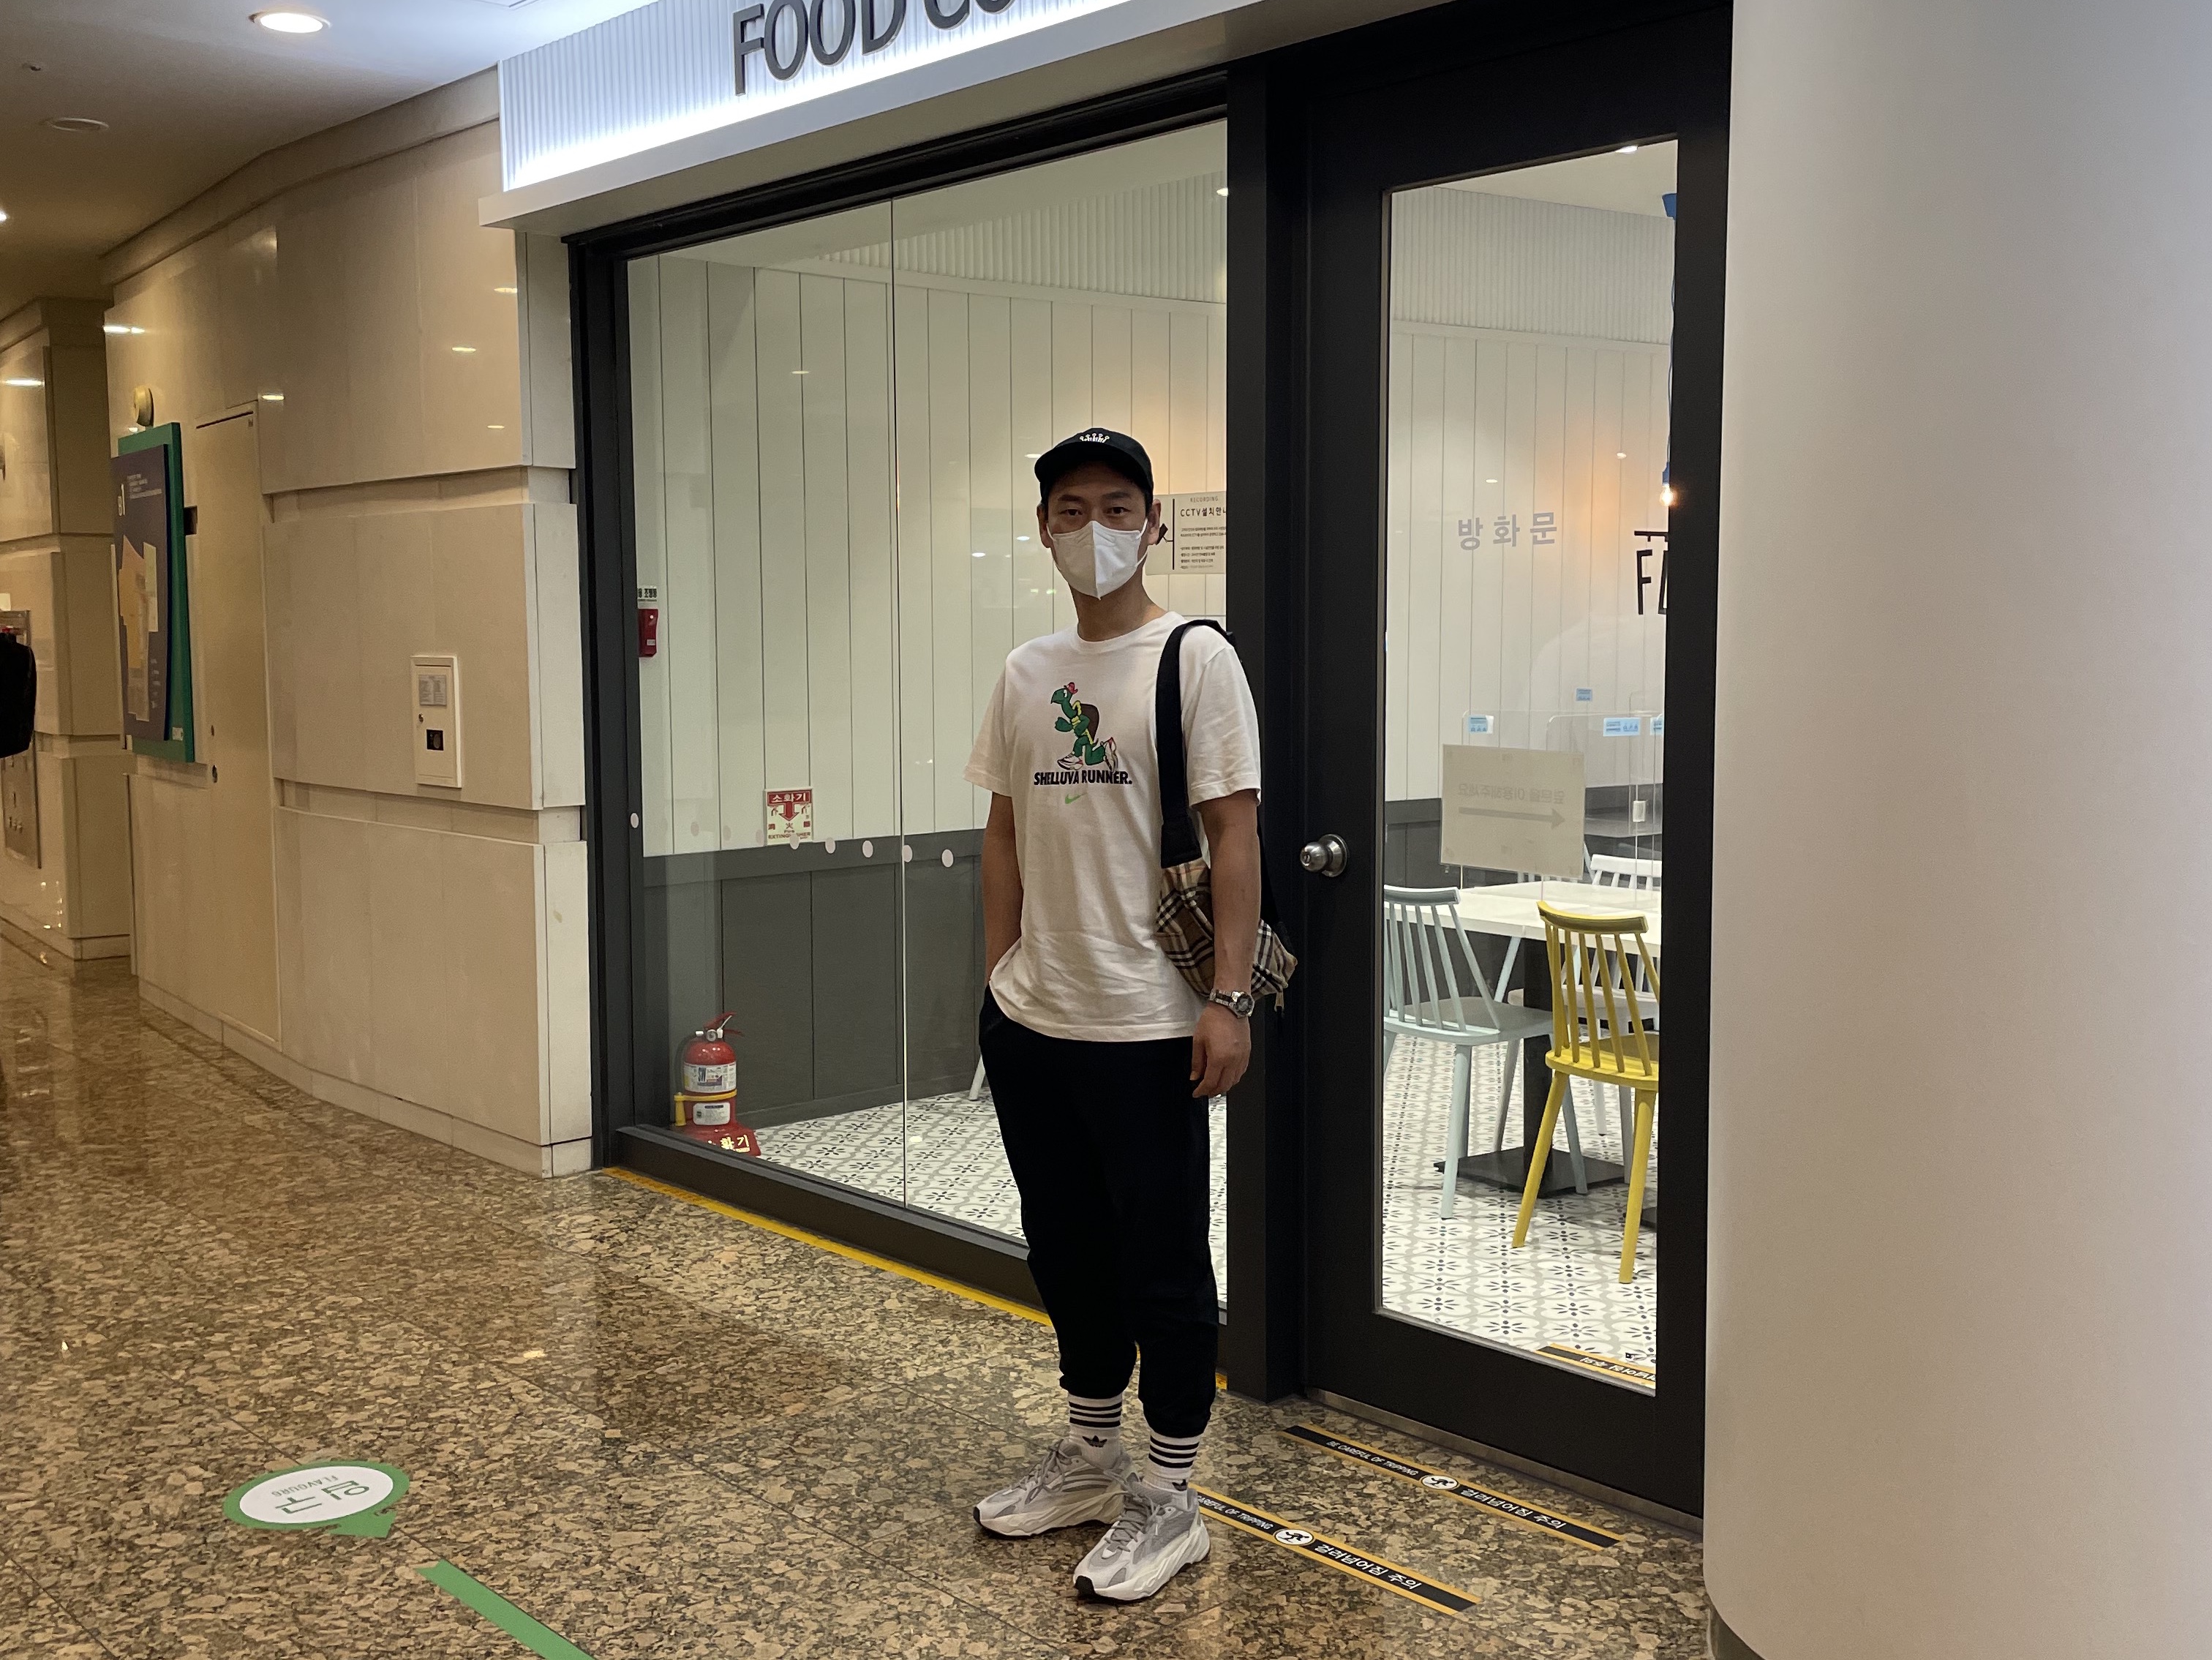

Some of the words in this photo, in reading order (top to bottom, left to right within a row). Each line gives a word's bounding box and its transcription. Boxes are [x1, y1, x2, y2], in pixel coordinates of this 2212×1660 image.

[733, 0, 908, 96] FOOD
[1034, 770, 1079, 785] SHELLUVA
[1082, 770, 1132, 785] RUNNER.
[772, 793, 805, 803] 소화기
[1383, 1461, 1419, 1476] TRIPPING
[1461, 1488, 1532, 1517] 걸려넘어짐
[1533, 1514, 1567, 1529] 주의
[1237, 1512, 1274, 1530] TRIPPING
[1314, 1544, 1388, 1576] 걸려넘어짐
[1388, 1573, 1422, 1590] 주의
